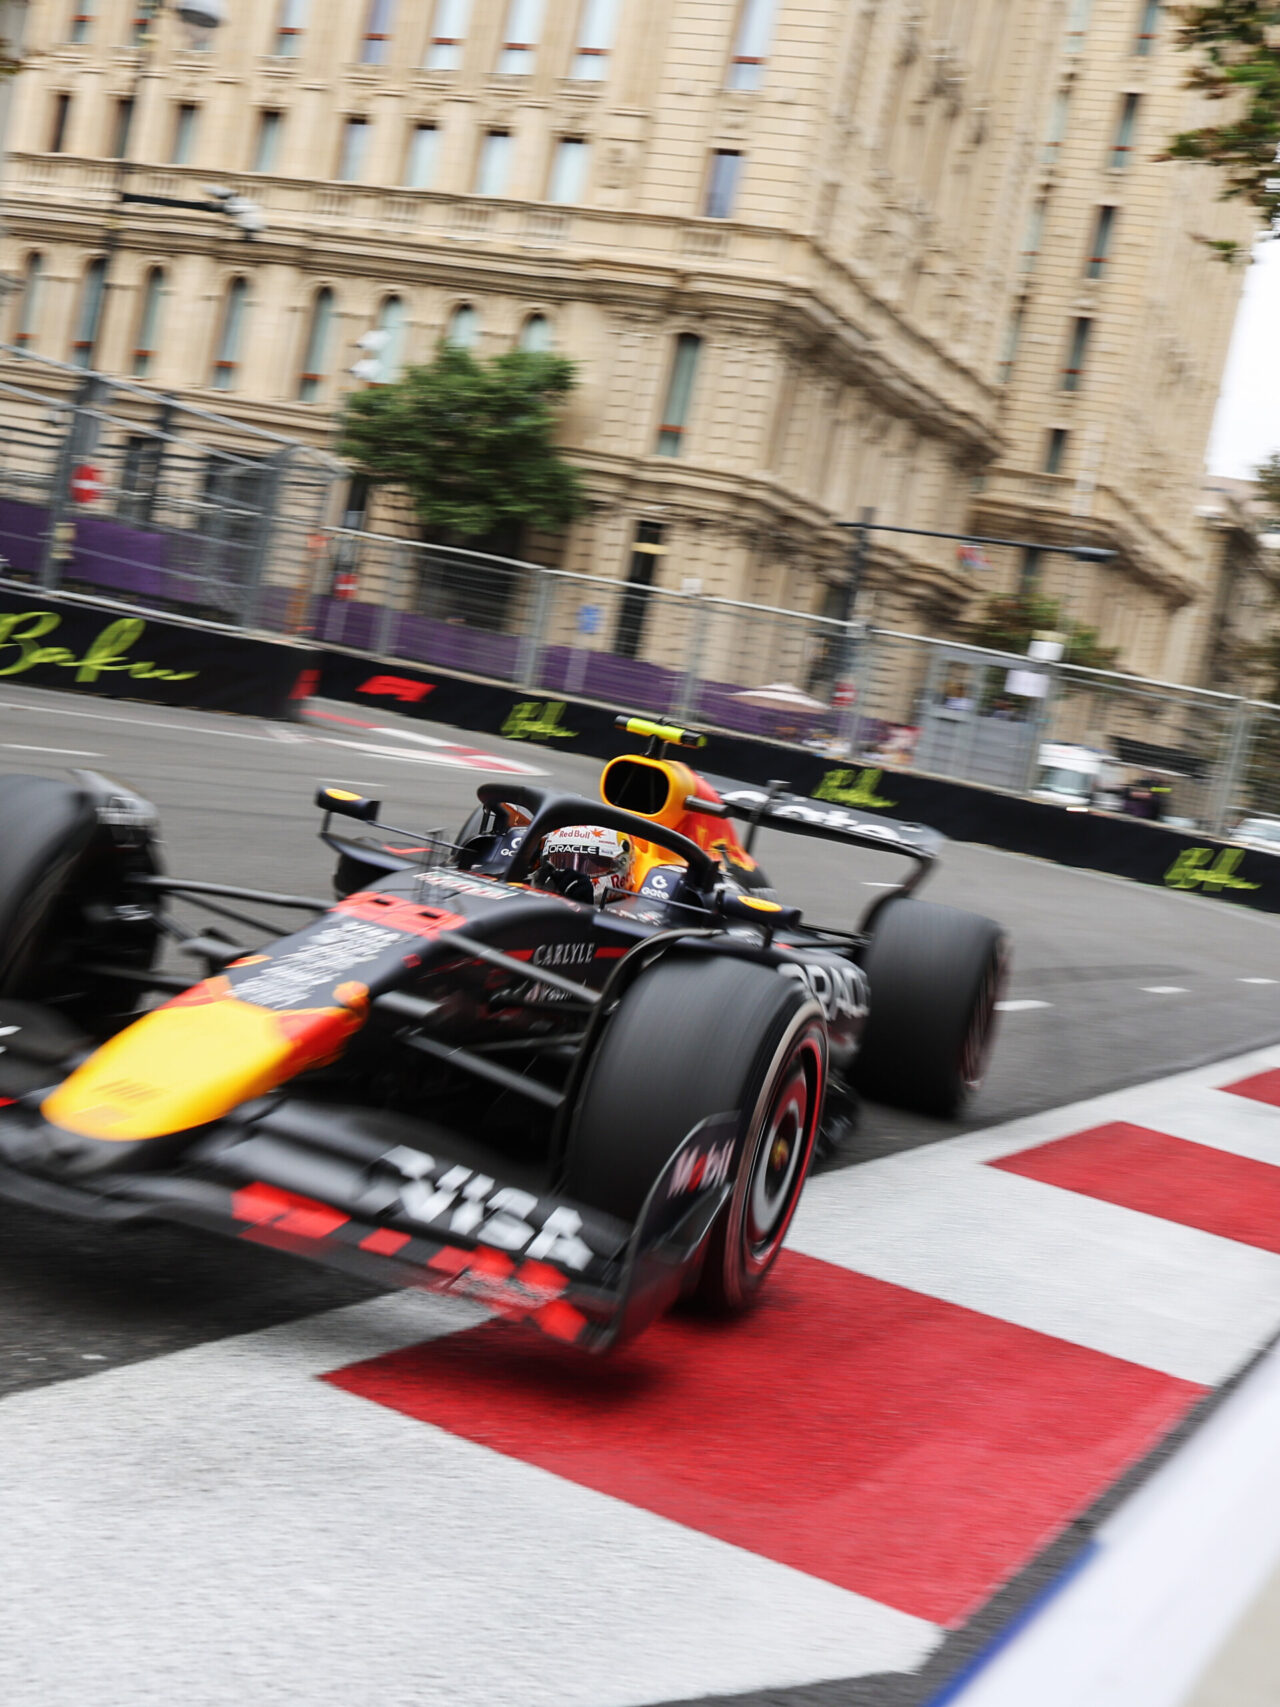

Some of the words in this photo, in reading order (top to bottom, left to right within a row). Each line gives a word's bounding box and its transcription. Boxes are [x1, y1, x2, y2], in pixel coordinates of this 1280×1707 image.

[558, 830, 573, 838] Red
[574, 830, 591, 839] Bull
[550, 845, 597, 854] ORACLE
[641, 887, 670, 900] Gate
[533, 943, 596, 966] CARLYLE
[666, 1137, 737, 1200] Mobil
